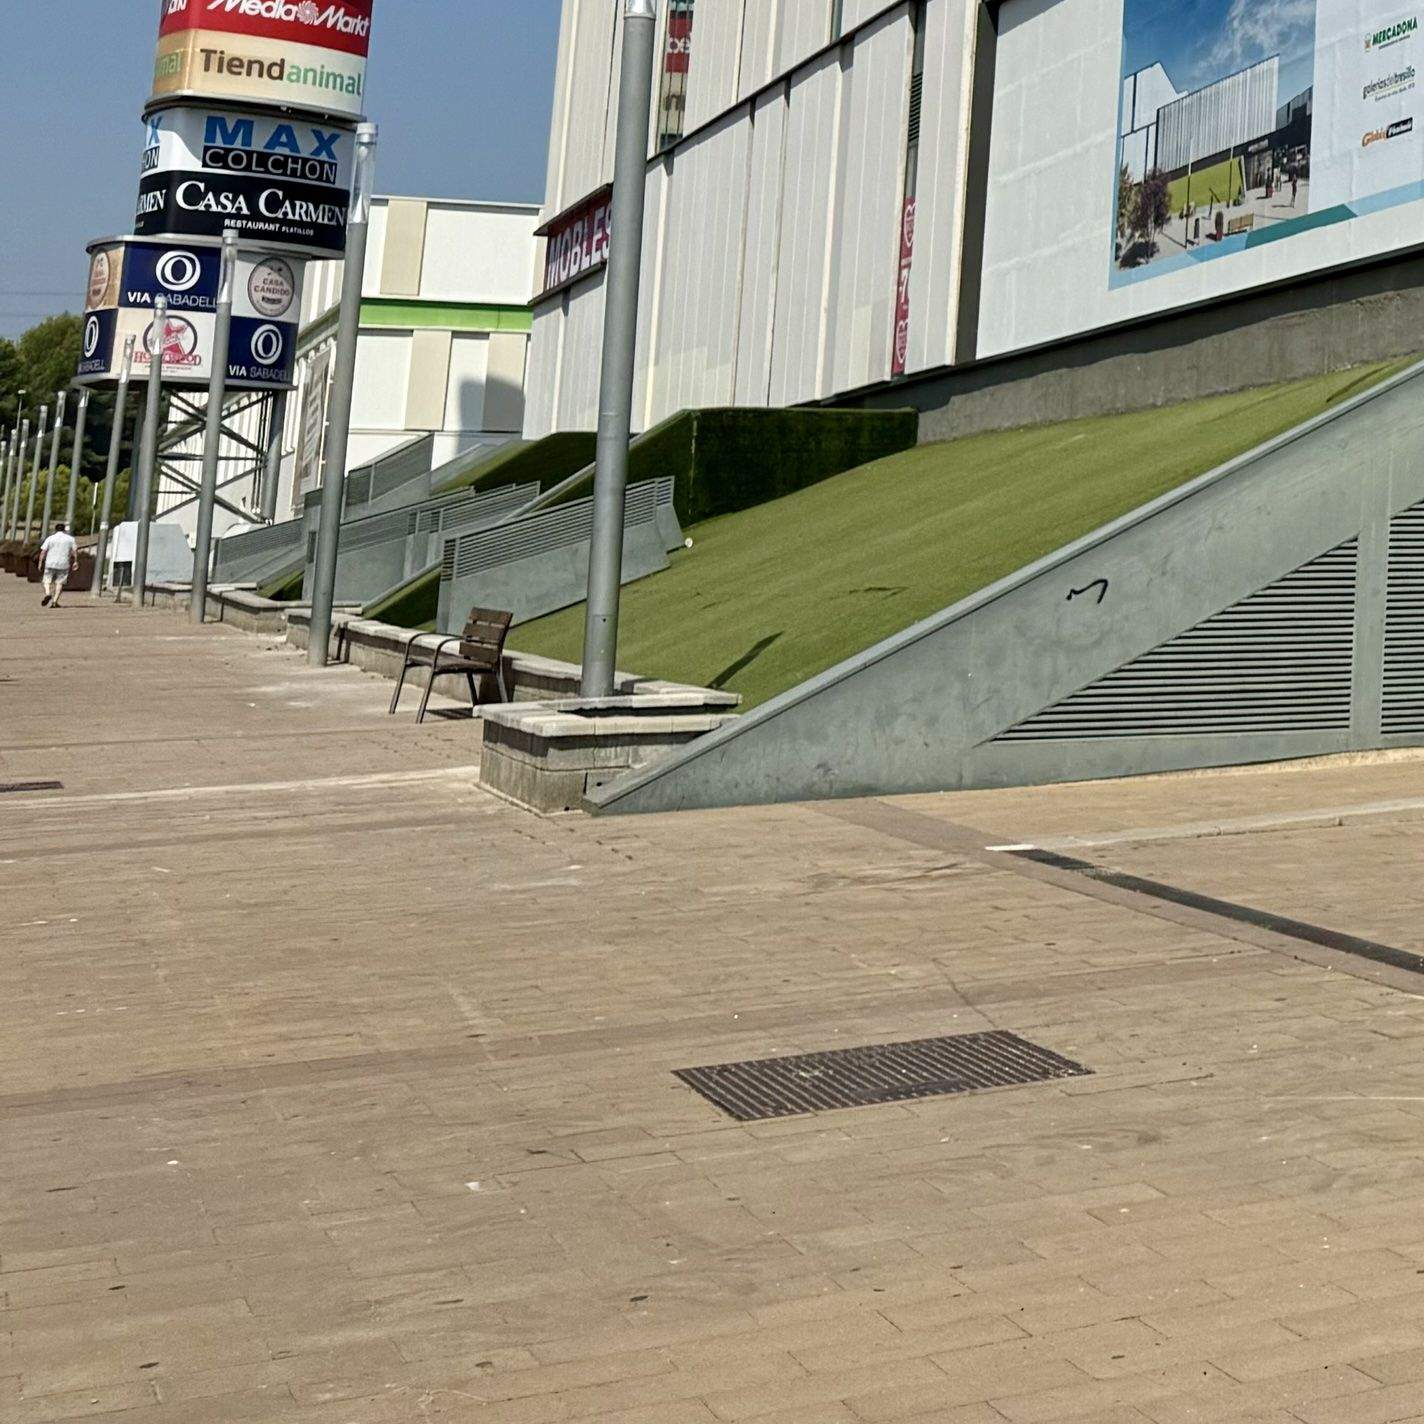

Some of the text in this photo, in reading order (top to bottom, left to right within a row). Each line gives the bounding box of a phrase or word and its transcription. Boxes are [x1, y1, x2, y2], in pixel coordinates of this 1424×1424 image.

[1372, 16, 1418, 46] MERCADONA
[200, 48, 361, 96] Tiendanimal
[204, 116, 341, 160] MAX
[204, 148, 336, 183] COLCHON
[175, 180, 349, 226] CASA CARMEN
[224, 218, 280, 232] RESTAURANT
[127, 291, 151, 304] VIA
[229, 364, 247, 377] VIA
